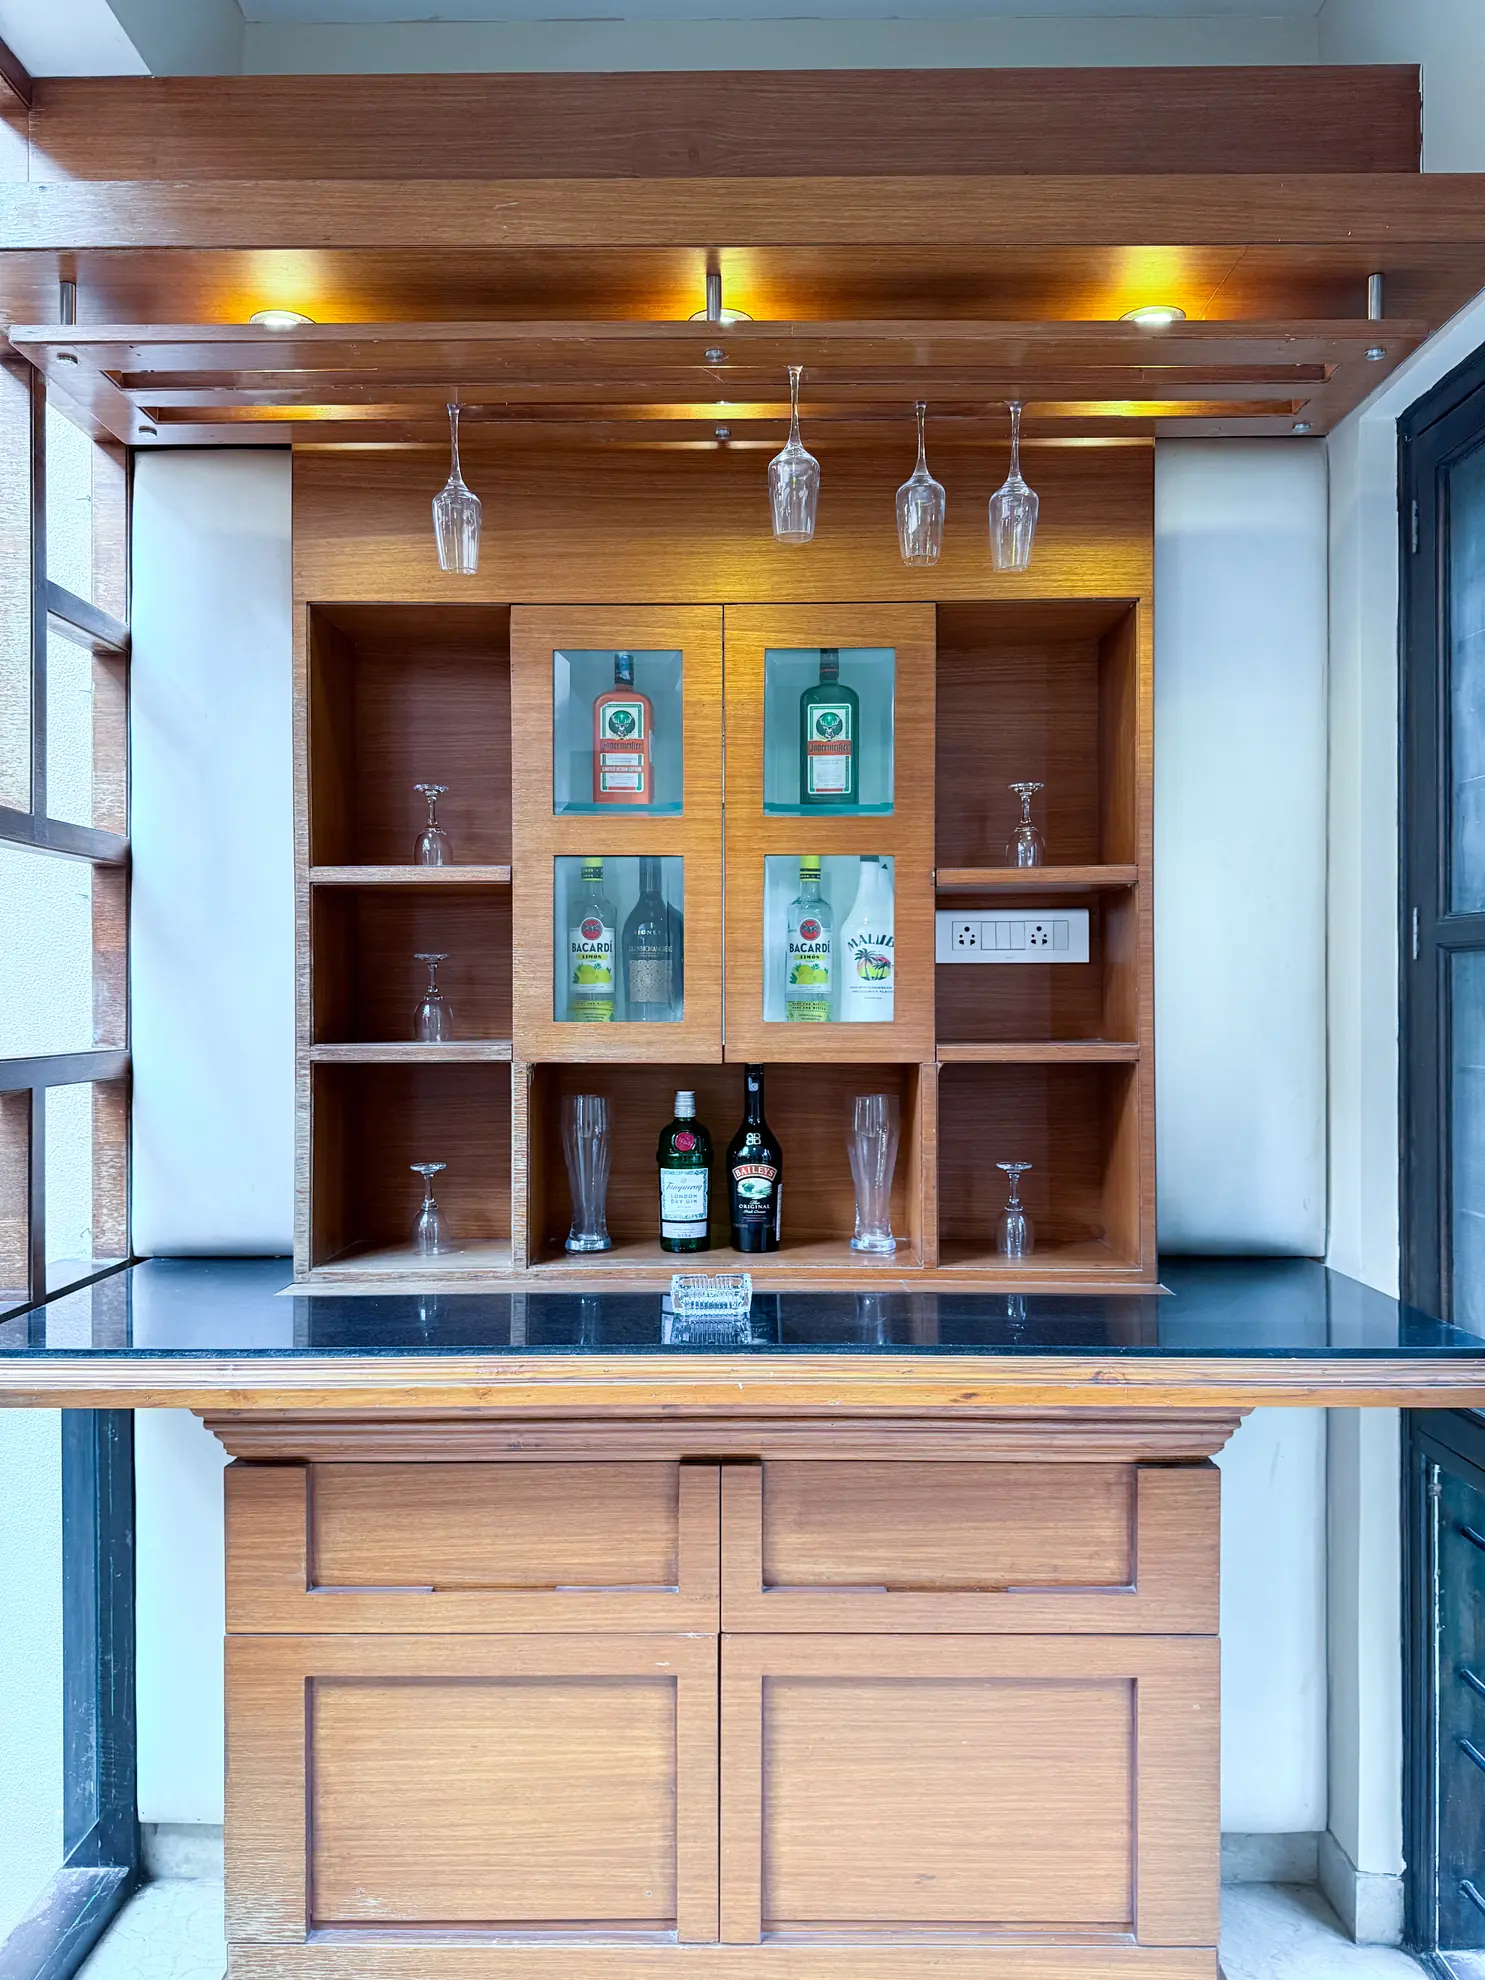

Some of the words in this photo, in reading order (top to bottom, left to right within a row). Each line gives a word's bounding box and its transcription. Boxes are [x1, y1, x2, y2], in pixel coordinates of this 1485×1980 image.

[572, 940, 612, 952] BACARDÍ
[789, 940, 830, 952] BACARDÍ
[735, 1166, 775, 1177] BAILEYS
[666, 1182, 702, 1192] Tanqueray
